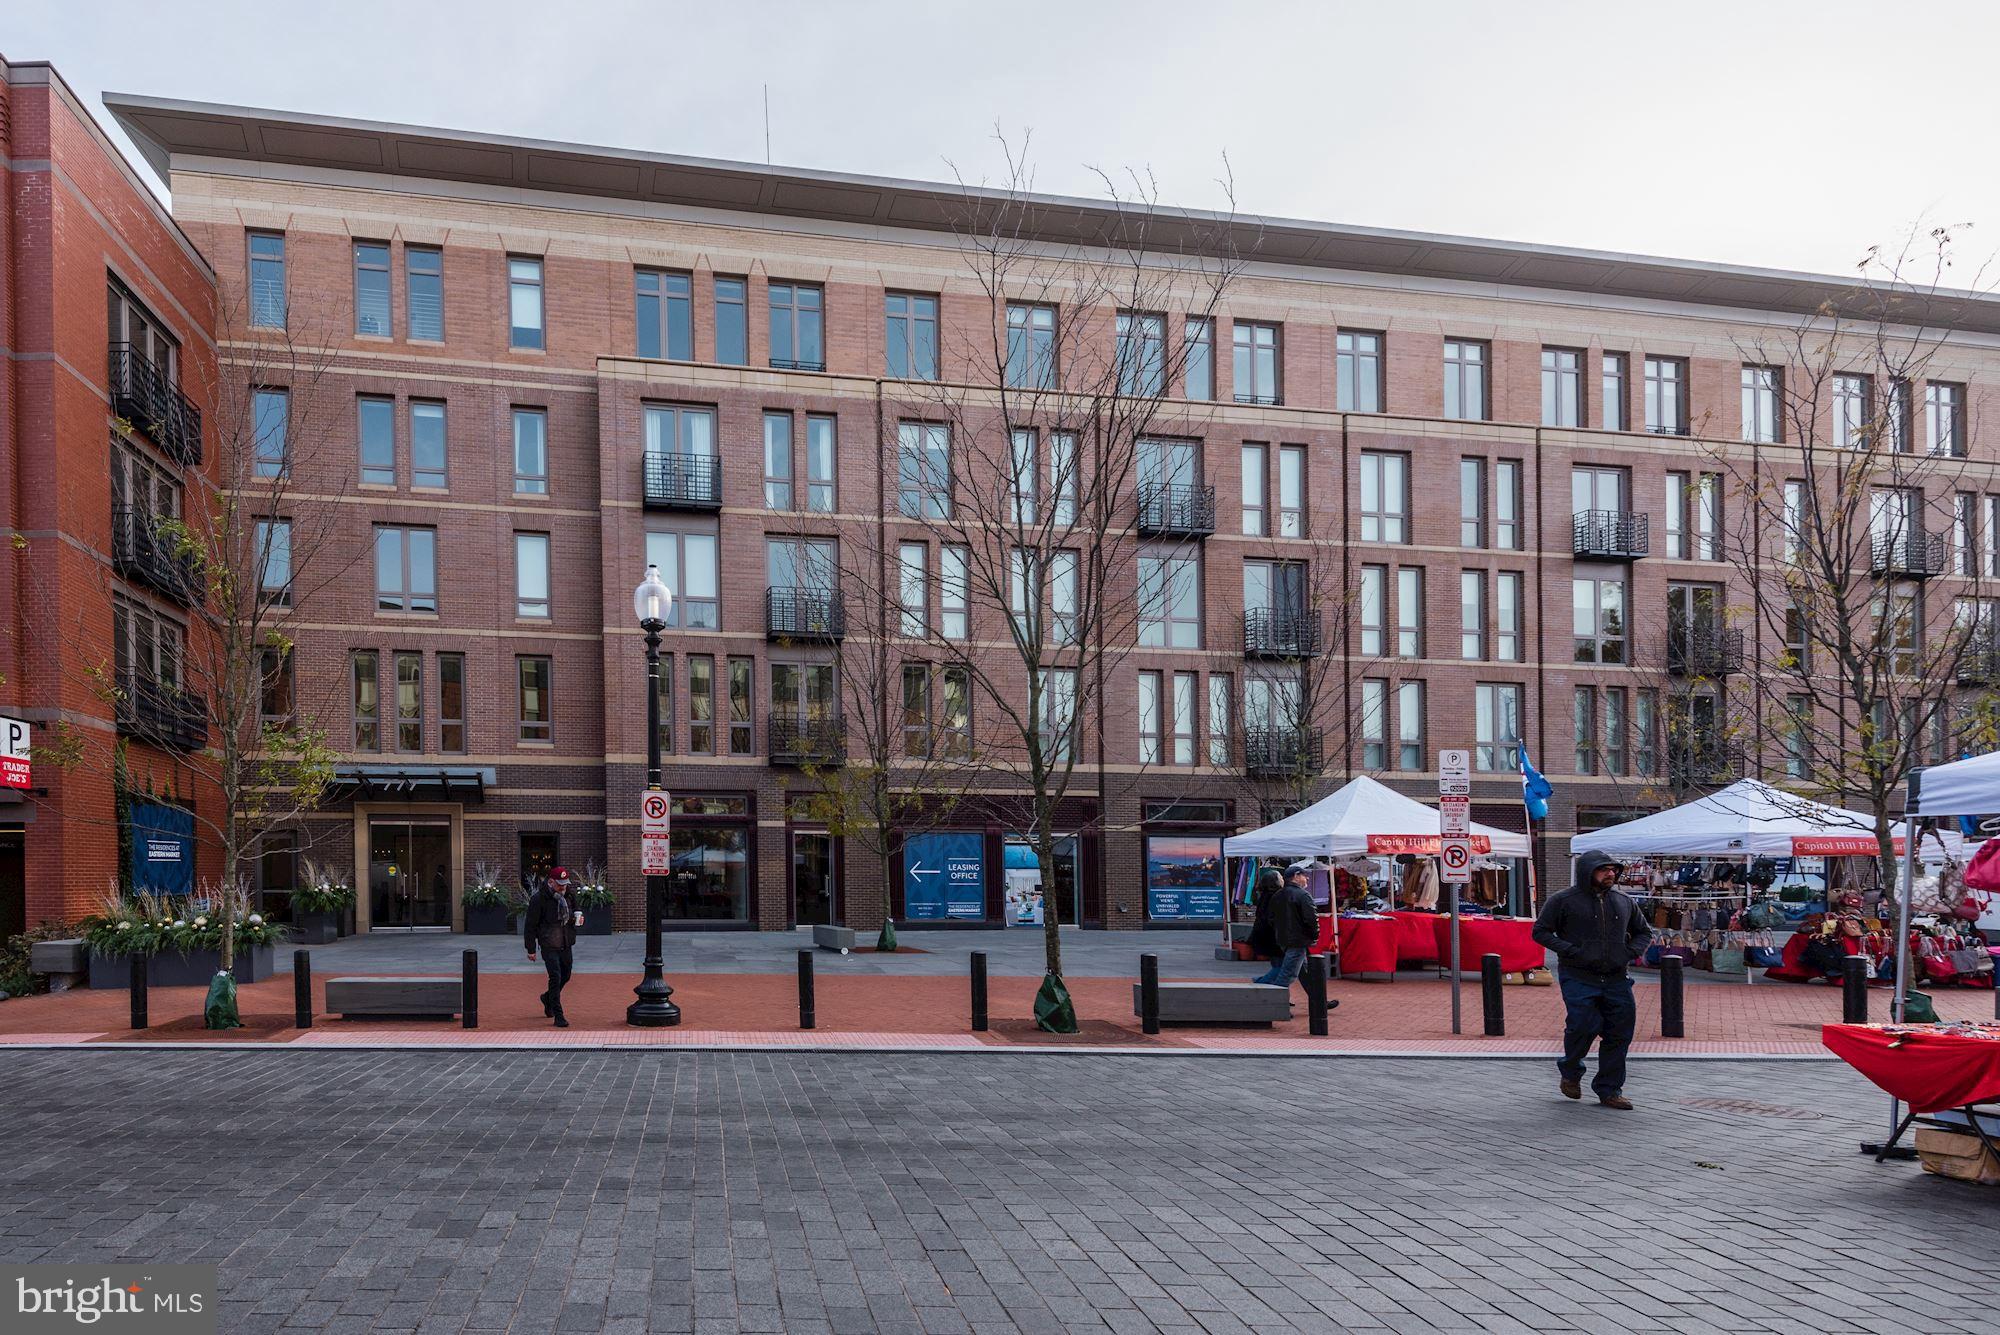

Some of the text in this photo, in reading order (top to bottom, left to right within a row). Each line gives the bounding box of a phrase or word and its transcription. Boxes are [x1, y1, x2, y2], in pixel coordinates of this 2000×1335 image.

[10, 723, 22, 754] P
[1451, 755, 1458, 763] P
[3, 761, 30, 773] TRADER
[7, 773, 27, 783] JOE'S
[651, 801, 663, 814] P
[1374, 838, 1407, 847] Capitol
[1409, 838, 1426, 846] Hill
[1795, 841, 1880, 851] Capitol Hill Flea
[1451, 850, 1462, 864] P
